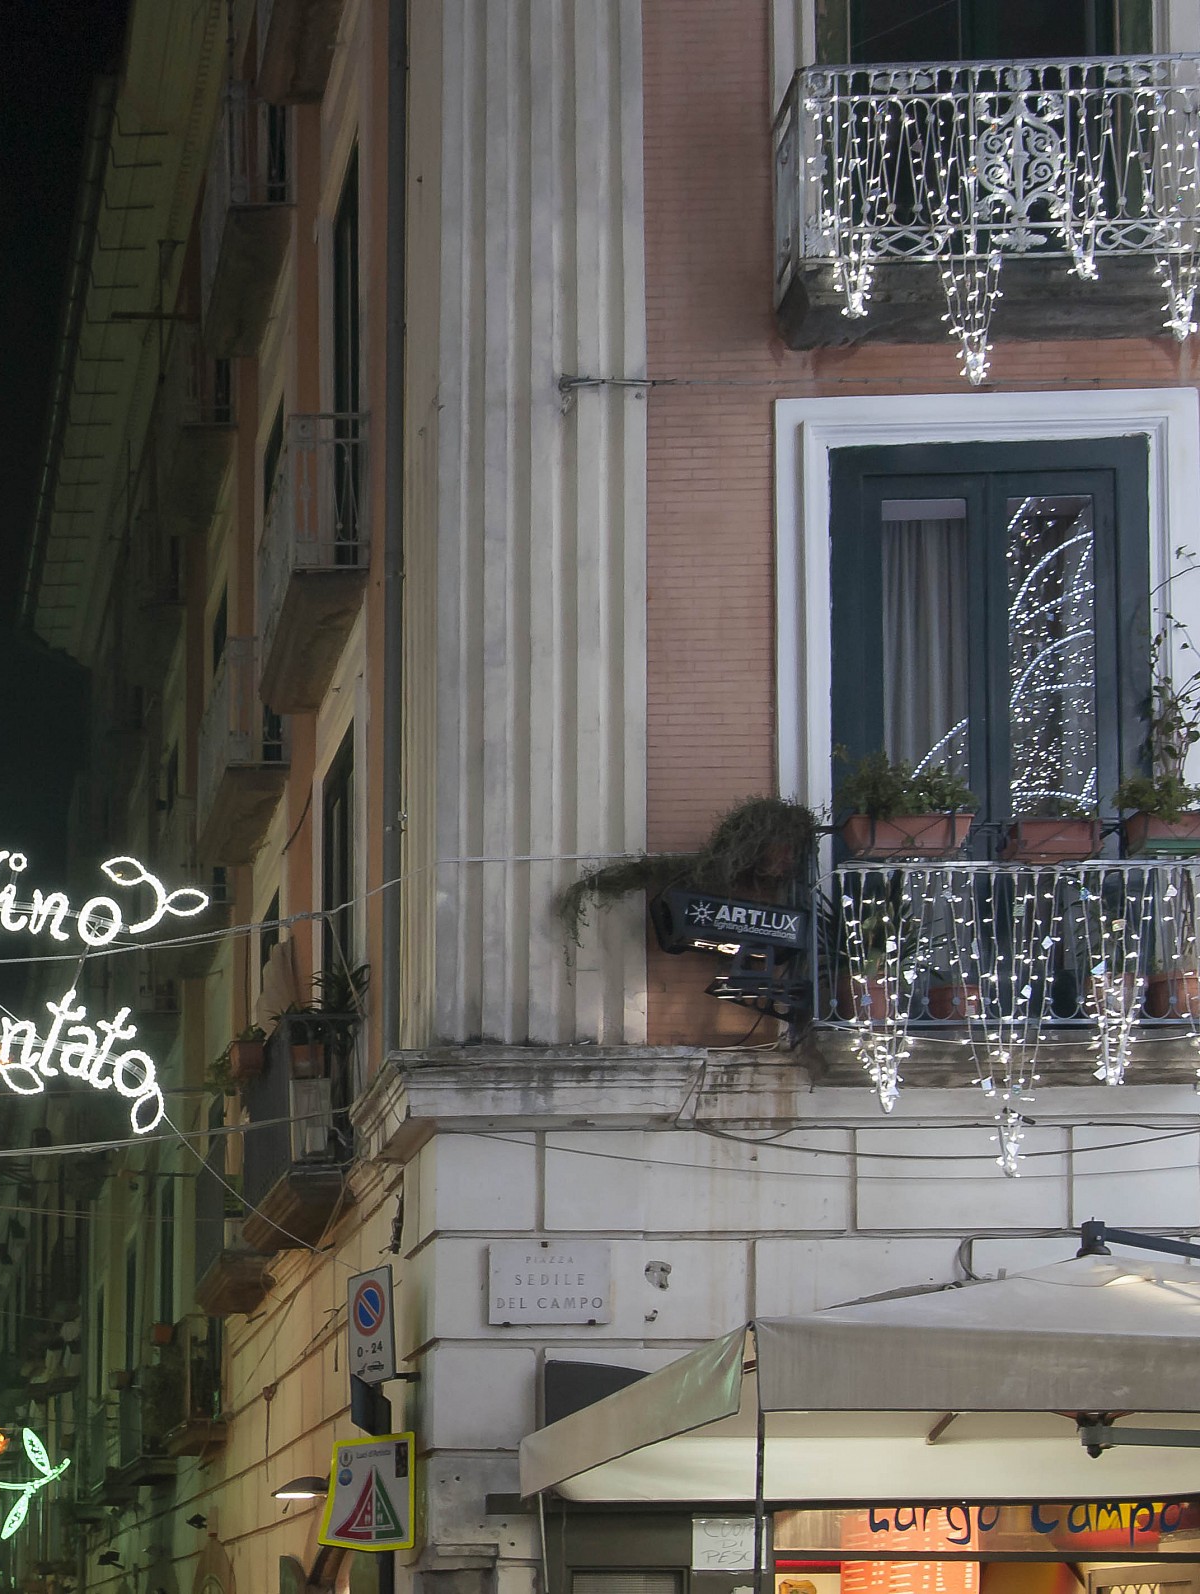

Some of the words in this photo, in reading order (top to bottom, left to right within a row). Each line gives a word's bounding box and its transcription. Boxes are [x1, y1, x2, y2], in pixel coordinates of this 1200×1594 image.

[716, 905, 799, 931] ARTLUX
[514, 1273, 586, 1286] SEDILE
[496, 1297, 528, 1309] DEL
[537, 1296, 604, 1309] CAMPO
[869, 1506, 1000, 1545] Largo
[1030, 1503, 1182, 1549] Campo
[701, 1549, 752, 1565] PESC
